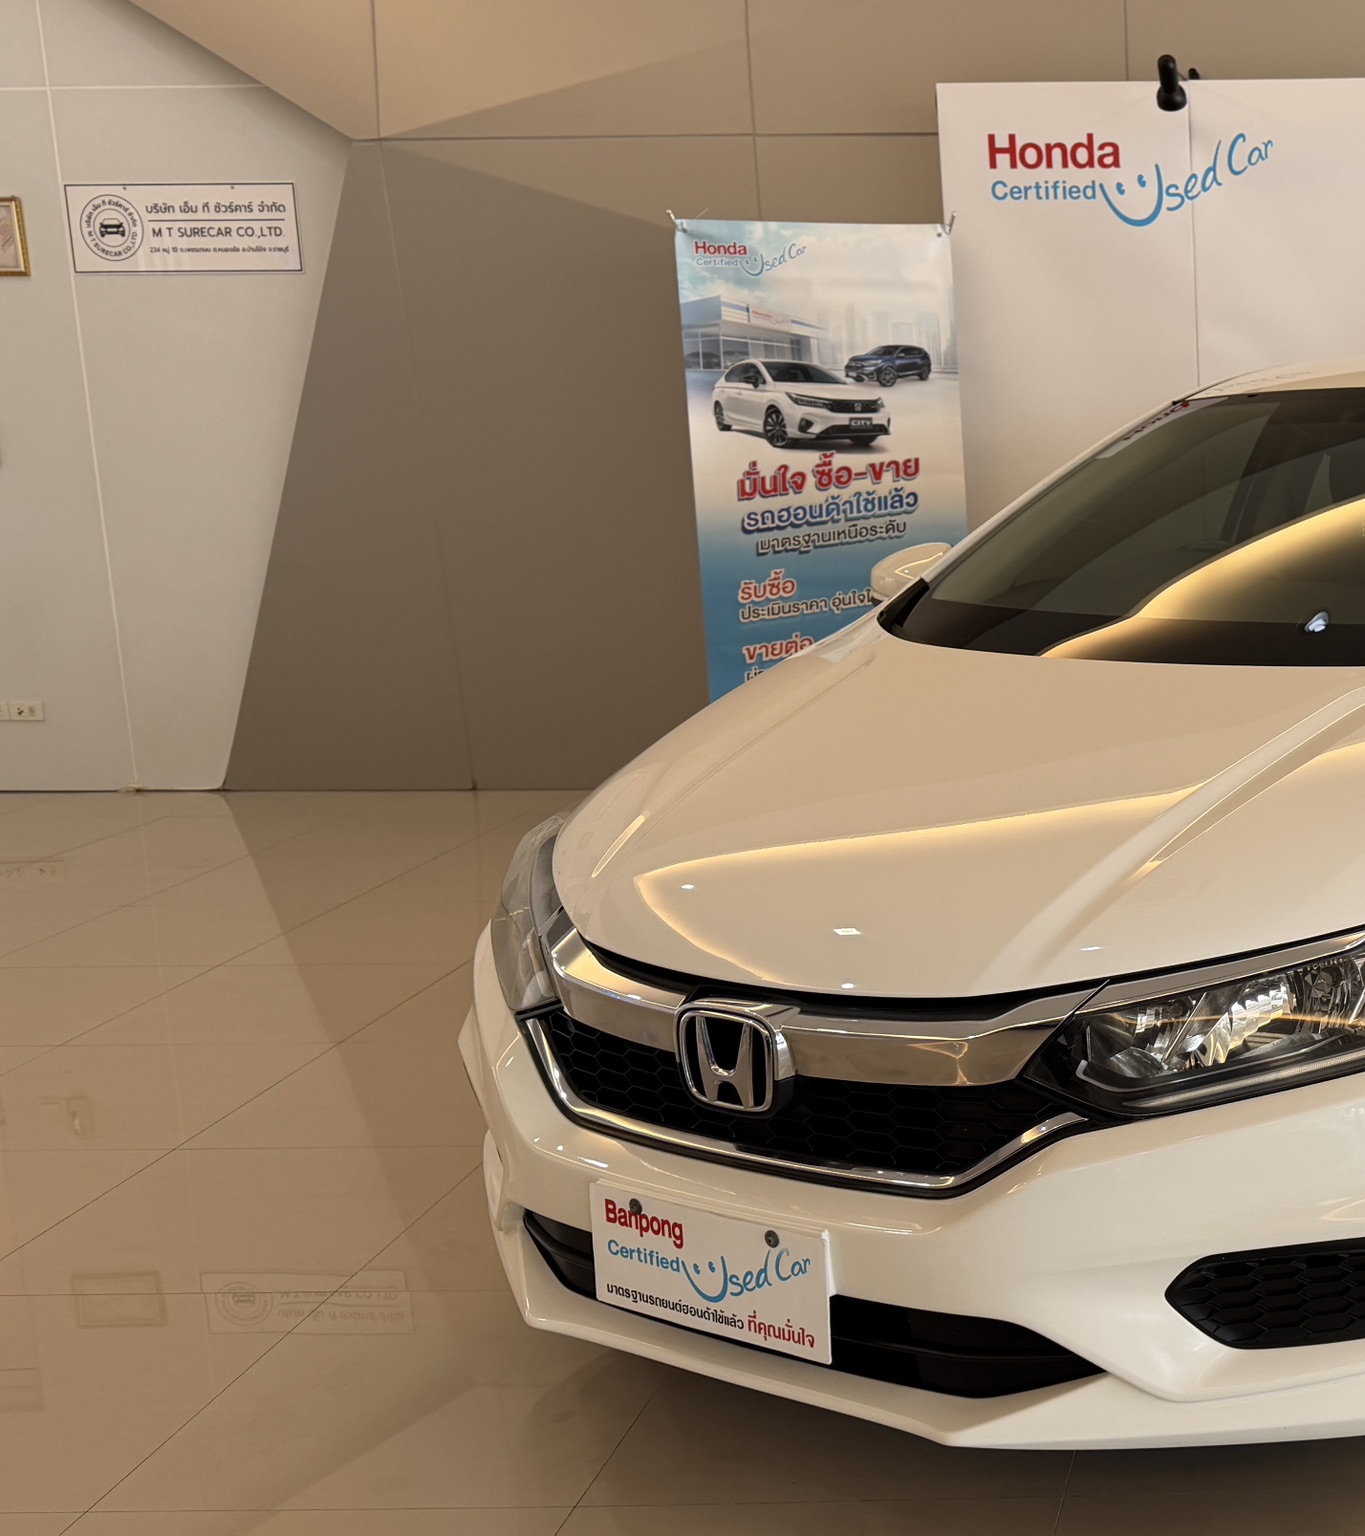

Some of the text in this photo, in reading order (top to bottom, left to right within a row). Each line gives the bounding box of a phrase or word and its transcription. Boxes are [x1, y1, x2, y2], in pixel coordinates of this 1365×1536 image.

[987, 133, 1121, 170] Honda
[991, 133, 1273, 227] Certified Used Car
[145, 203, 175, 214] บริษัท
[179, 201, 198, 214] เอ็ม
[257, 201, 286, 213] จำกัด
[152, 227, 162, 238] M
[166, 227, 173, 238] T
[177, 226, 232, 238] SURECAR
[694, 241, 748, 256] Honda
[696, 243, 807, 277] Certified Used Car
[738, 451, 921, 501] มั่นใจ ซื้อ-ขาย
[744, 487, 919, 531] รถฮอนด้าใช้แล้ว
[758, 519, 908, 553] มาตรฐานเหนือระดับ
[740, 569, 797, 602] รับซื้อ
[740, 599, 828, 621] ประเมินราคา
[604, 1198, 685, 1250] Banpong
[607, 1239, 812, 1304] Certified Used Car
[606, 1282, 816, 1348] มาตรฐานรถยนต์ฮอนด้าใช้แล้ว ที่คุณมั่นใจ
